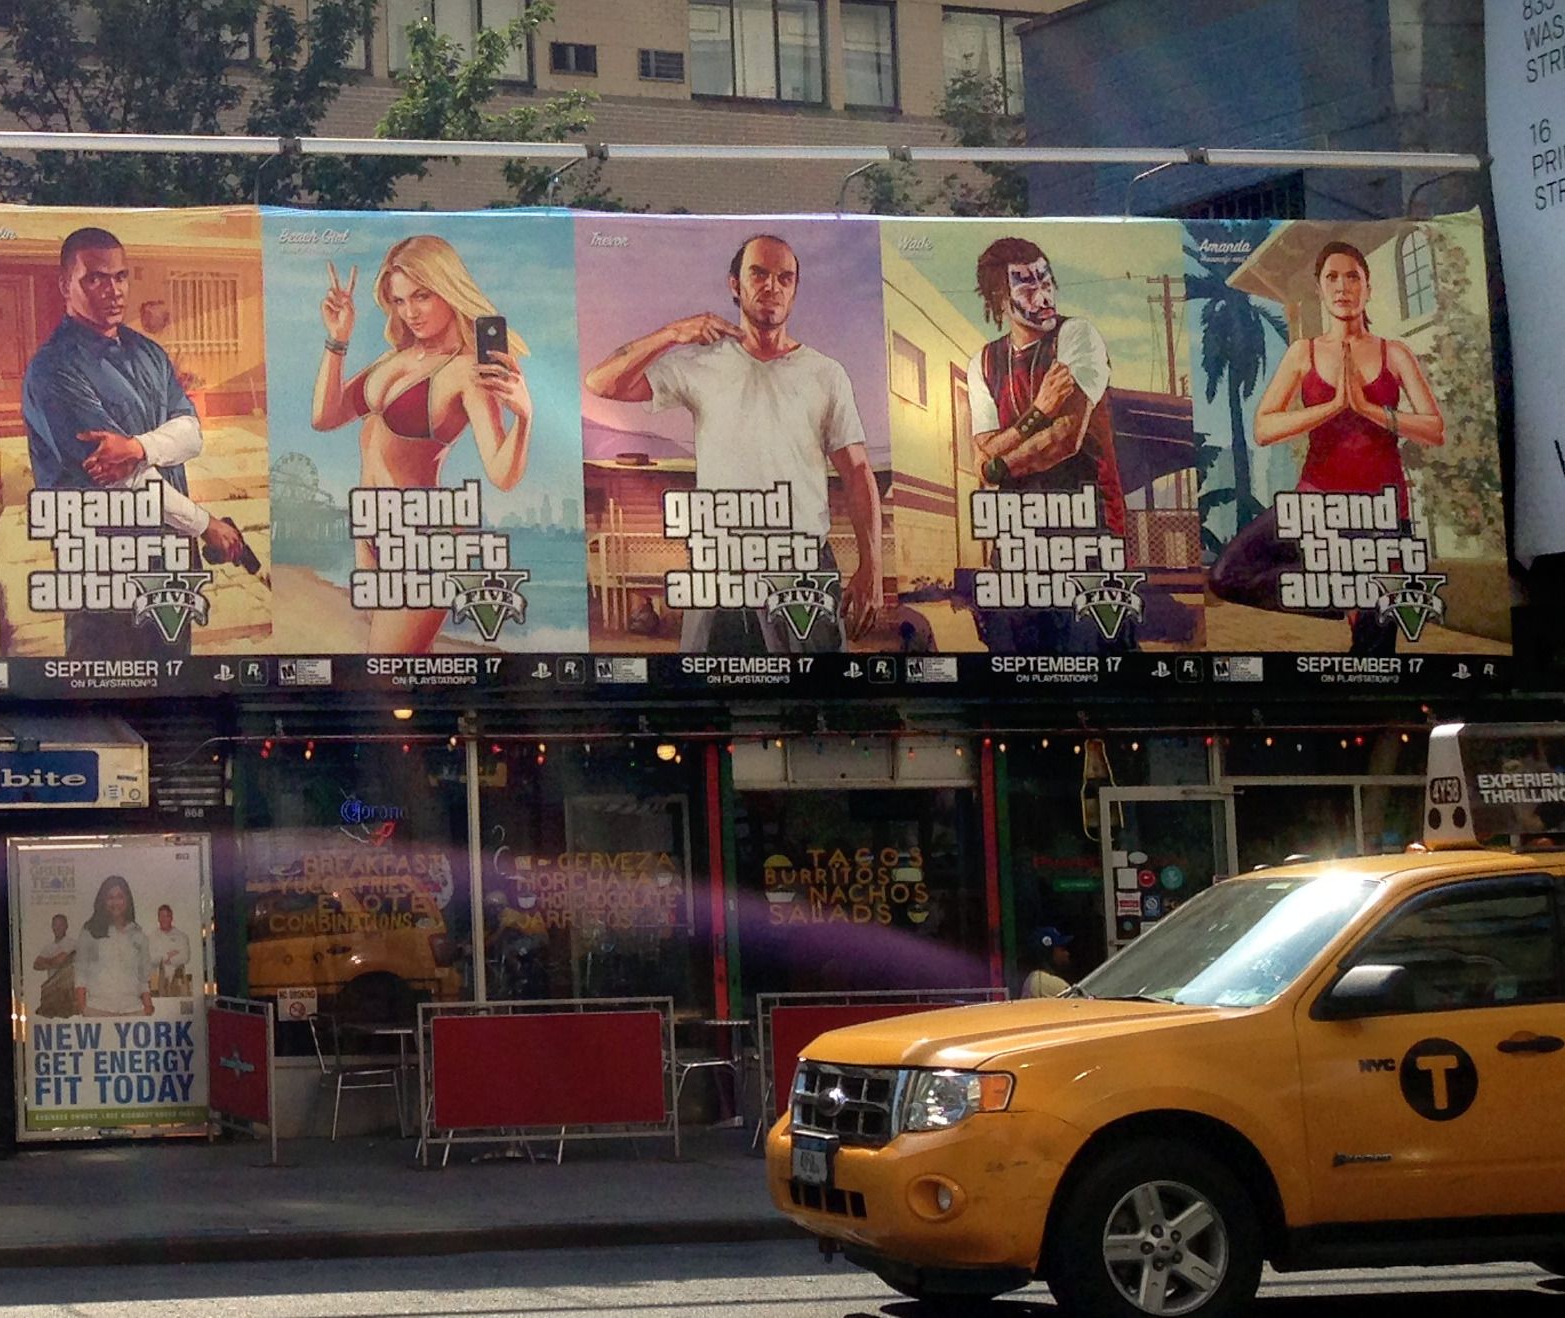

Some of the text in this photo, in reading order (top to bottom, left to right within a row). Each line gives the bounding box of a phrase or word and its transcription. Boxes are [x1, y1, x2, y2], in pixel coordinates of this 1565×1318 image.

[1526, 45, 1565, 83] STR
[1529, 118, 1551, 146] 16
[1532, 145, 1565, 178] PRI
[1199, 238, 1252, 252] Amanda
[53, 527, 190, 572] theft
[375, 527, 509, 571] theft
[687, 528, 820, 571] theft
[995, 529, 1126, 571] theft
[1300, 529, 1427, 573] theft
[28, 572, 137, 611] auto
[349, 571, 455, 609] auto
[664, 571, 768, 609] auto
[975, 571, 1076, 609] auto
[1279, 571, 1380, 609] auto
[45, 660, 182, 677] SEPTEMBER 17
[367, 657, 502, 674] SEPTEMBER 17
[682, 657, 814, 673] SEPTEMBER 17
[991, 657, 1122, 672] SEPTEMBER 17
[1296, 657, 1424, 672] SEPTEMBER 17
[71, 679, 86, 688] ON
[392, 676, 407, 685] ON
[706, 675, 721, 684] ON
[1016, 674, 1030, 682] ON
[1321, 674, 1335, 682] ON
[0, 769, 88, 787] bite
[557, 852, 676, 871] CERVEZA
[806, 847, 923, 868] TACOS
[764, 868, 889, 885] BURRITOS
[809, 883, 930, 903] NACHOS
[269, 912, 413, 933] COMBINATIONS
[769, 904, 892, 925] SALADS
[35, 1021, 194, 1050] NEW YORK
[35, 1050, 194, 1075] GET ENERGY
[1358, 1059, 1396, 1072] NYC
[35, 1074, 195, 1105] FIT TODAY
